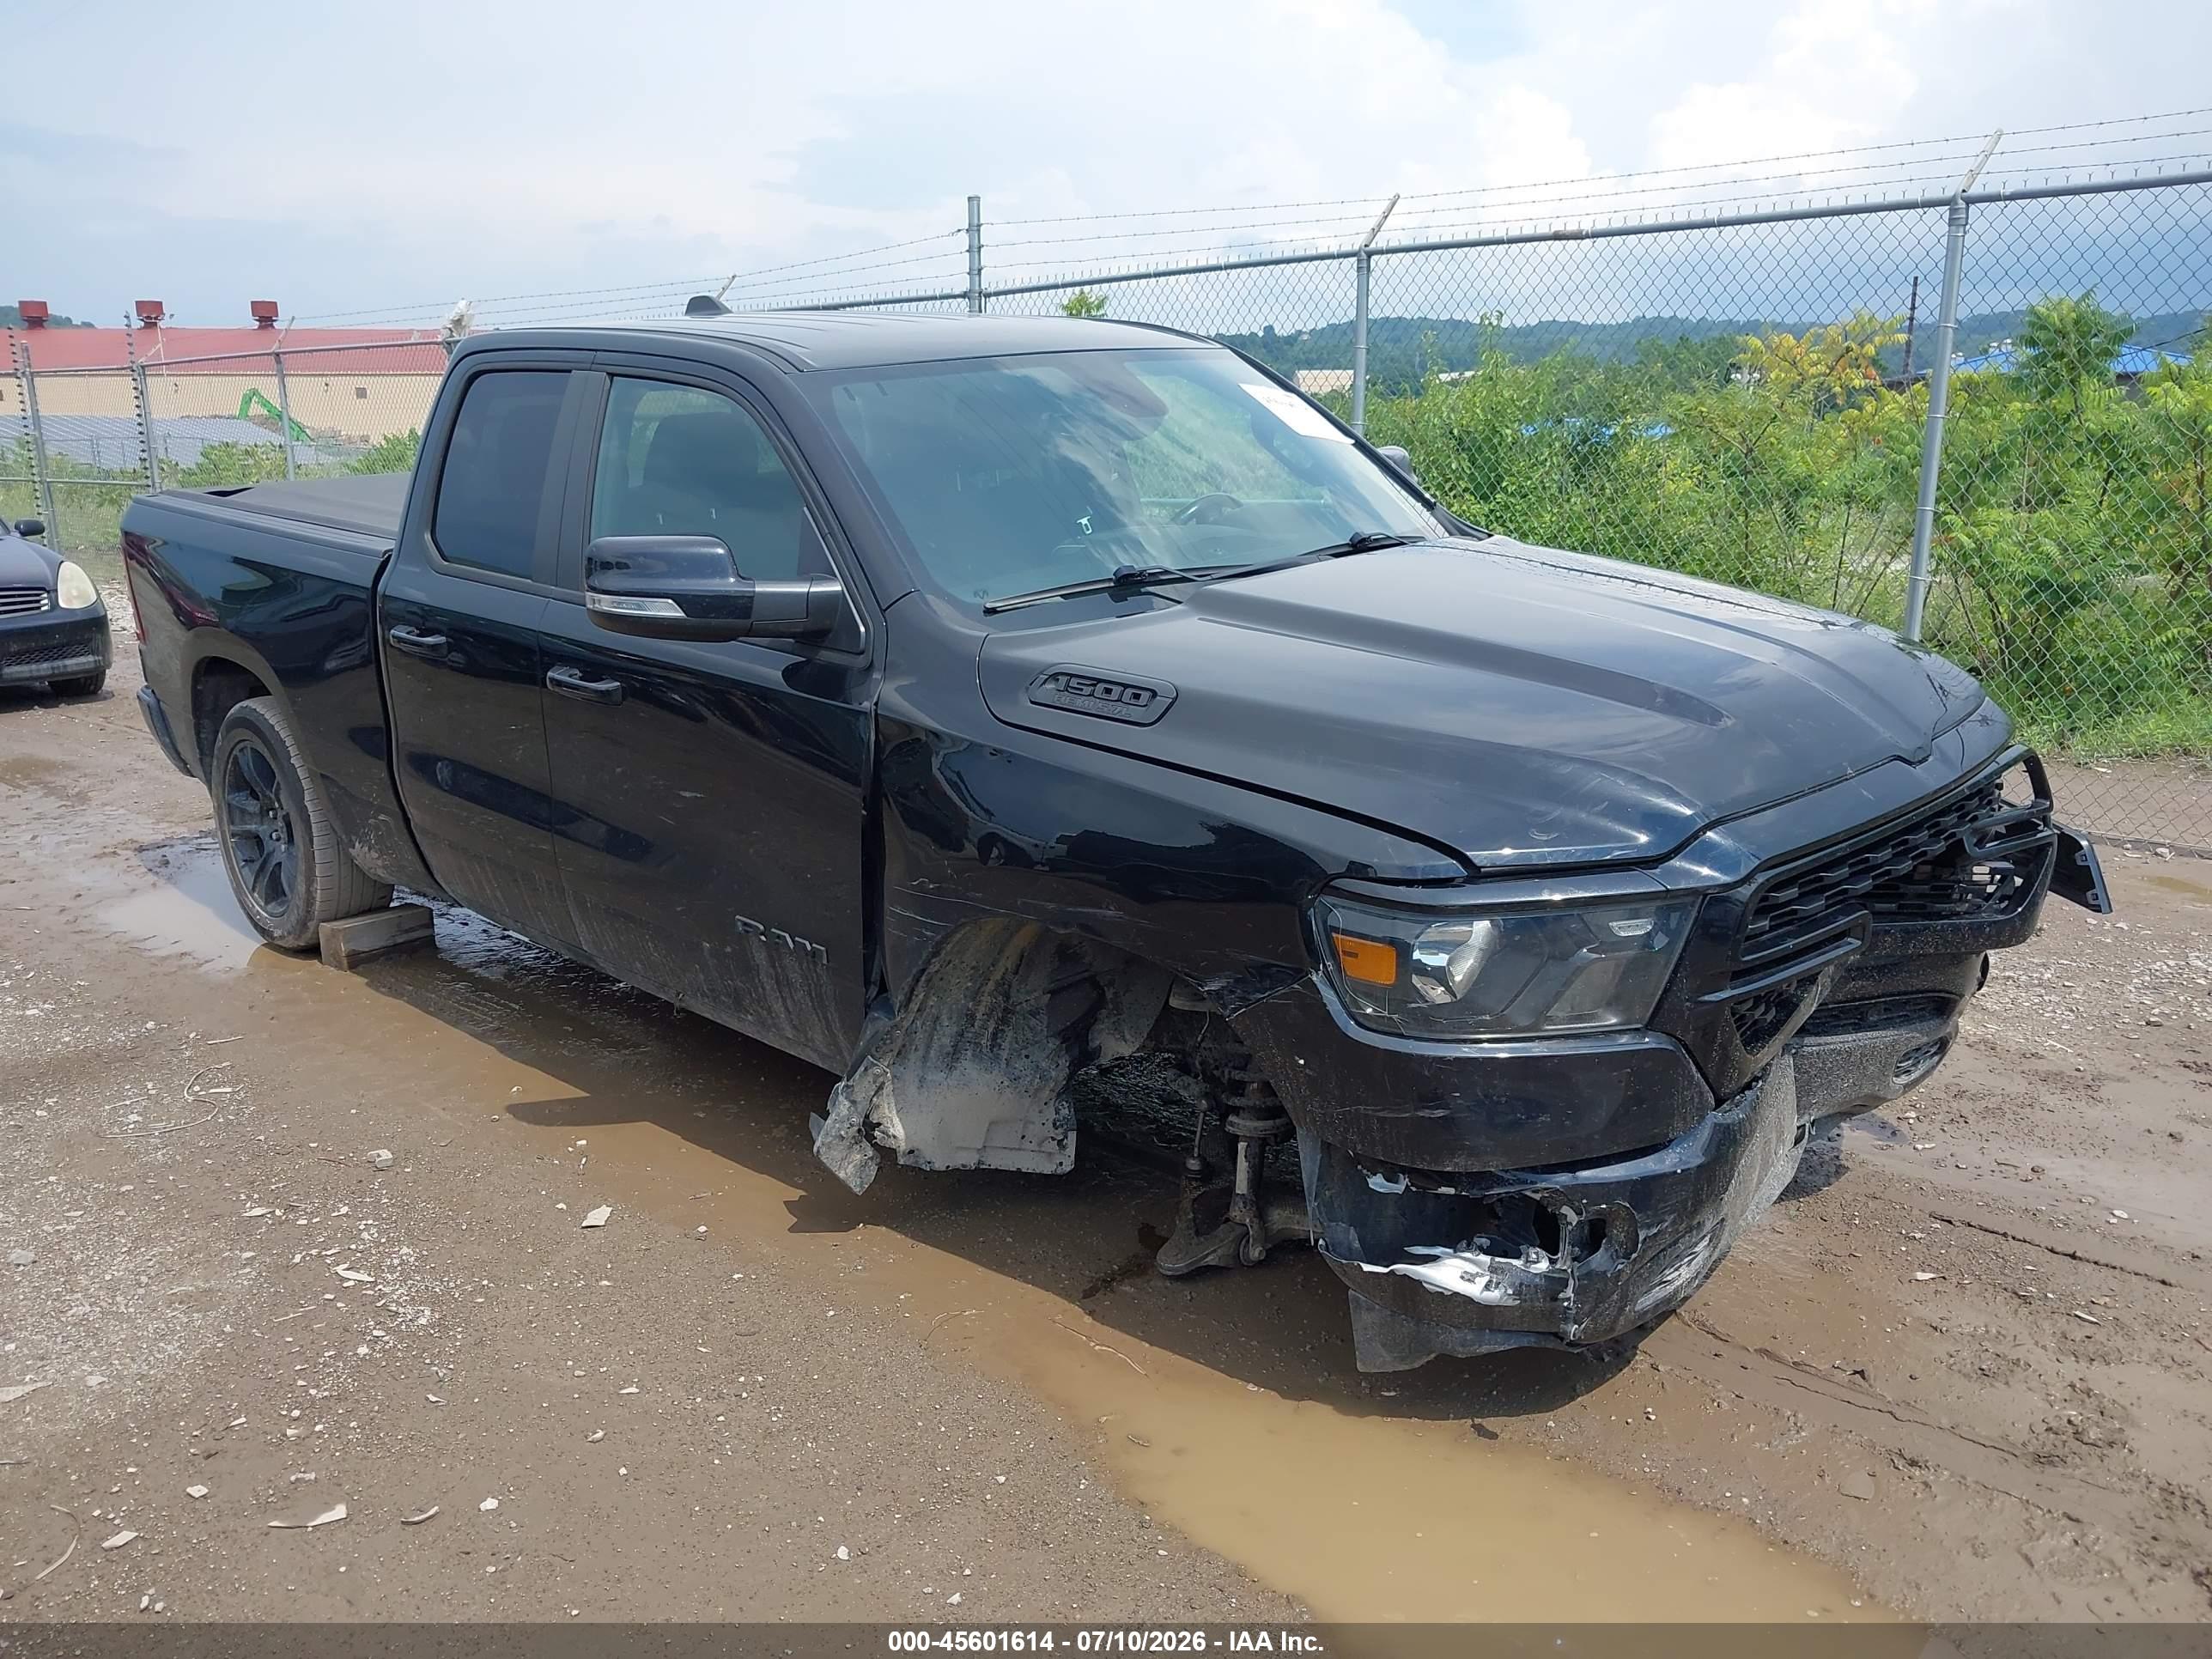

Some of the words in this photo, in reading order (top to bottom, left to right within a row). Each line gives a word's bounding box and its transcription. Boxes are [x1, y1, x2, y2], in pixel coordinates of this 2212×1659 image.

[1053, 693, 1094, 708] HEMI
[1054, 675, 1153, 707] 1500
[734, 915, 830, 965] RAM
